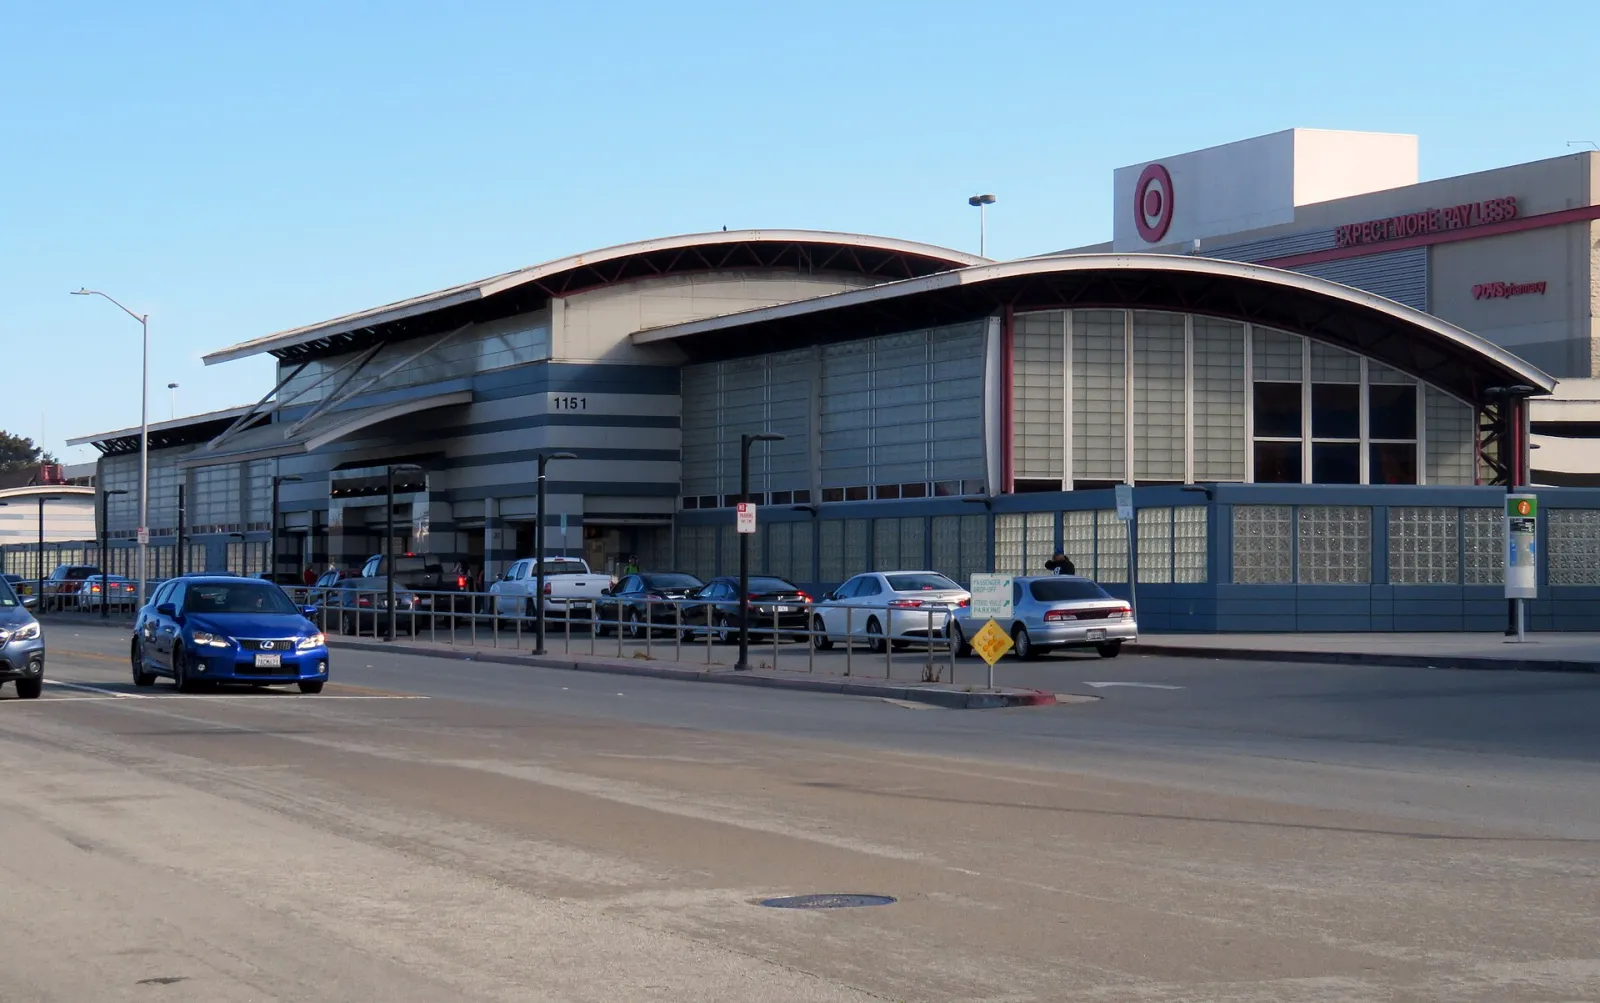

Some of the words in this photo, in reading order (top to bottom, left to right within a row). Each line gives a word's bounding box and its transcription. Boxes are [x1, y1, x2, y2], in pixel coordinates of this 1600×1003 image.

[1335, 217, 1392, 248] EXPECT
[1394, 208, 1441, 238] MORE
[1443, 203, 1473, 229] PAY
[1475, 196, 1518, 223] LESS
[554, 397, 586, 410] 1151
